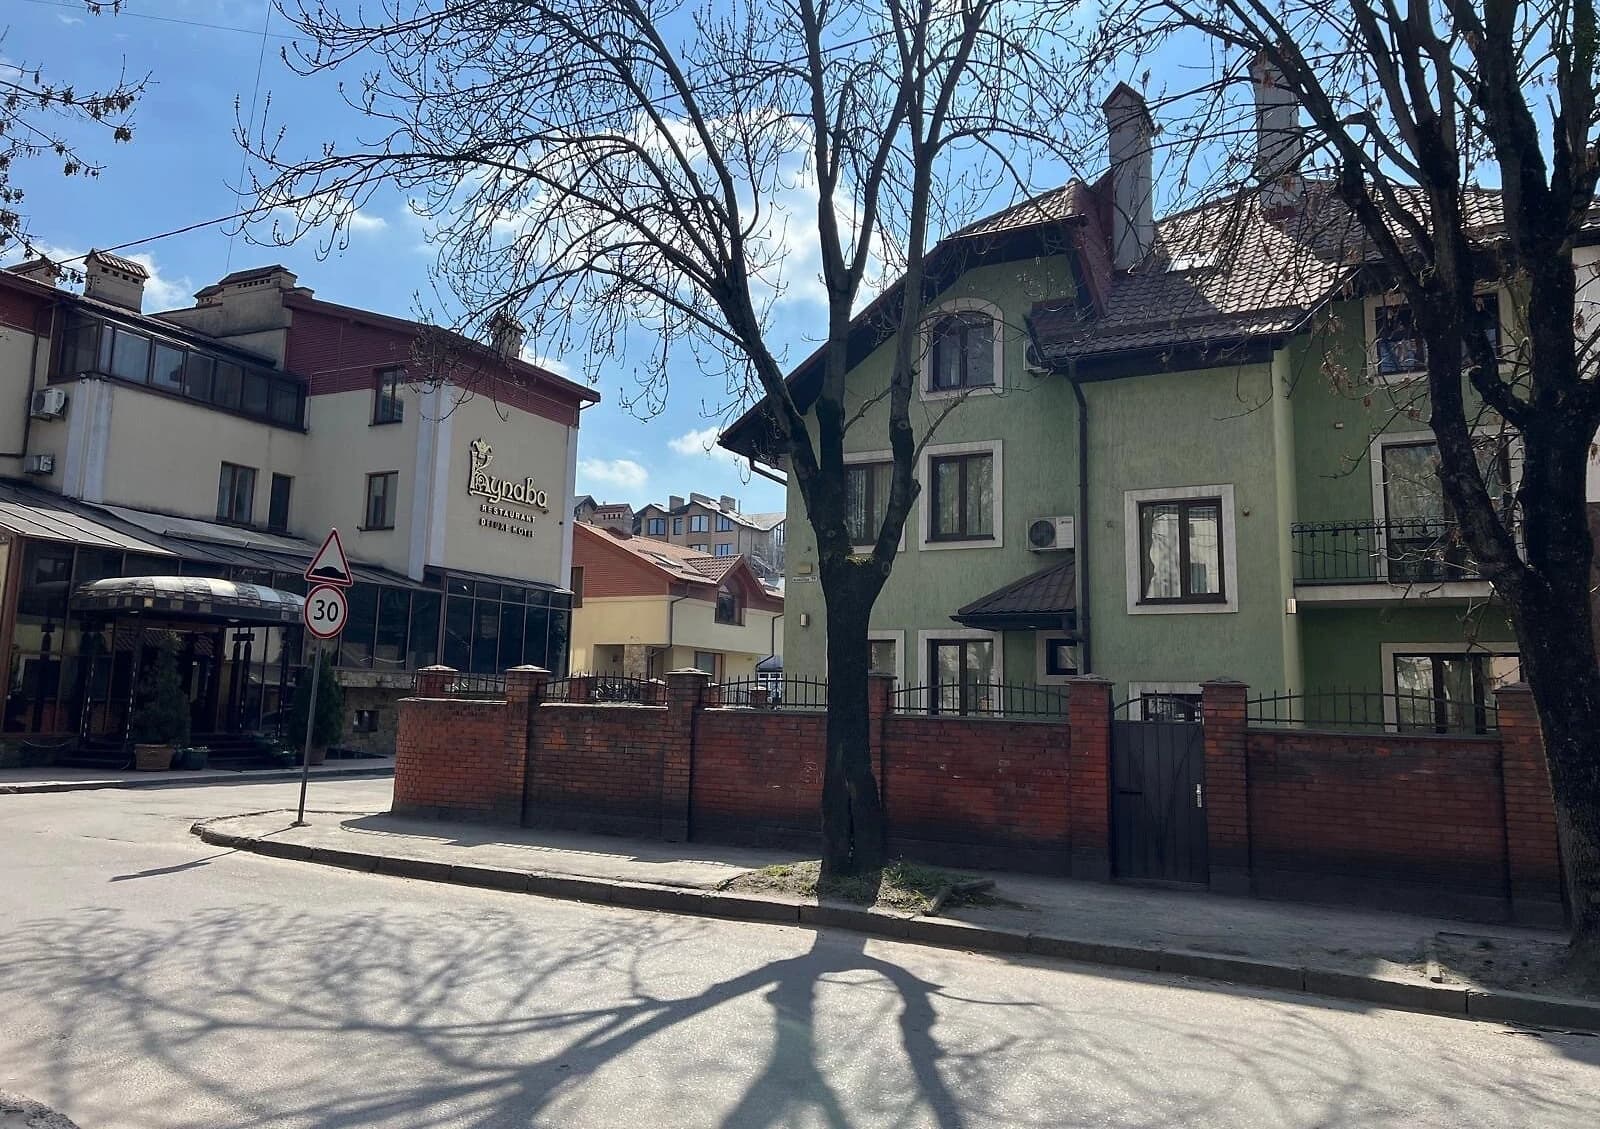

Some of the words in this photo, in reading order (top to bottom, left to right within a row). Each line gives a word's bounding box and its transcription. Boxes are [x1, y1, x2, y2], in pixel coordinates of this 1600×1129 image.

[480, 504, 536, 523] RESTAURANT
[479, 518, 509, 533] DELUXE
[313, 599, 339, 622] 30
